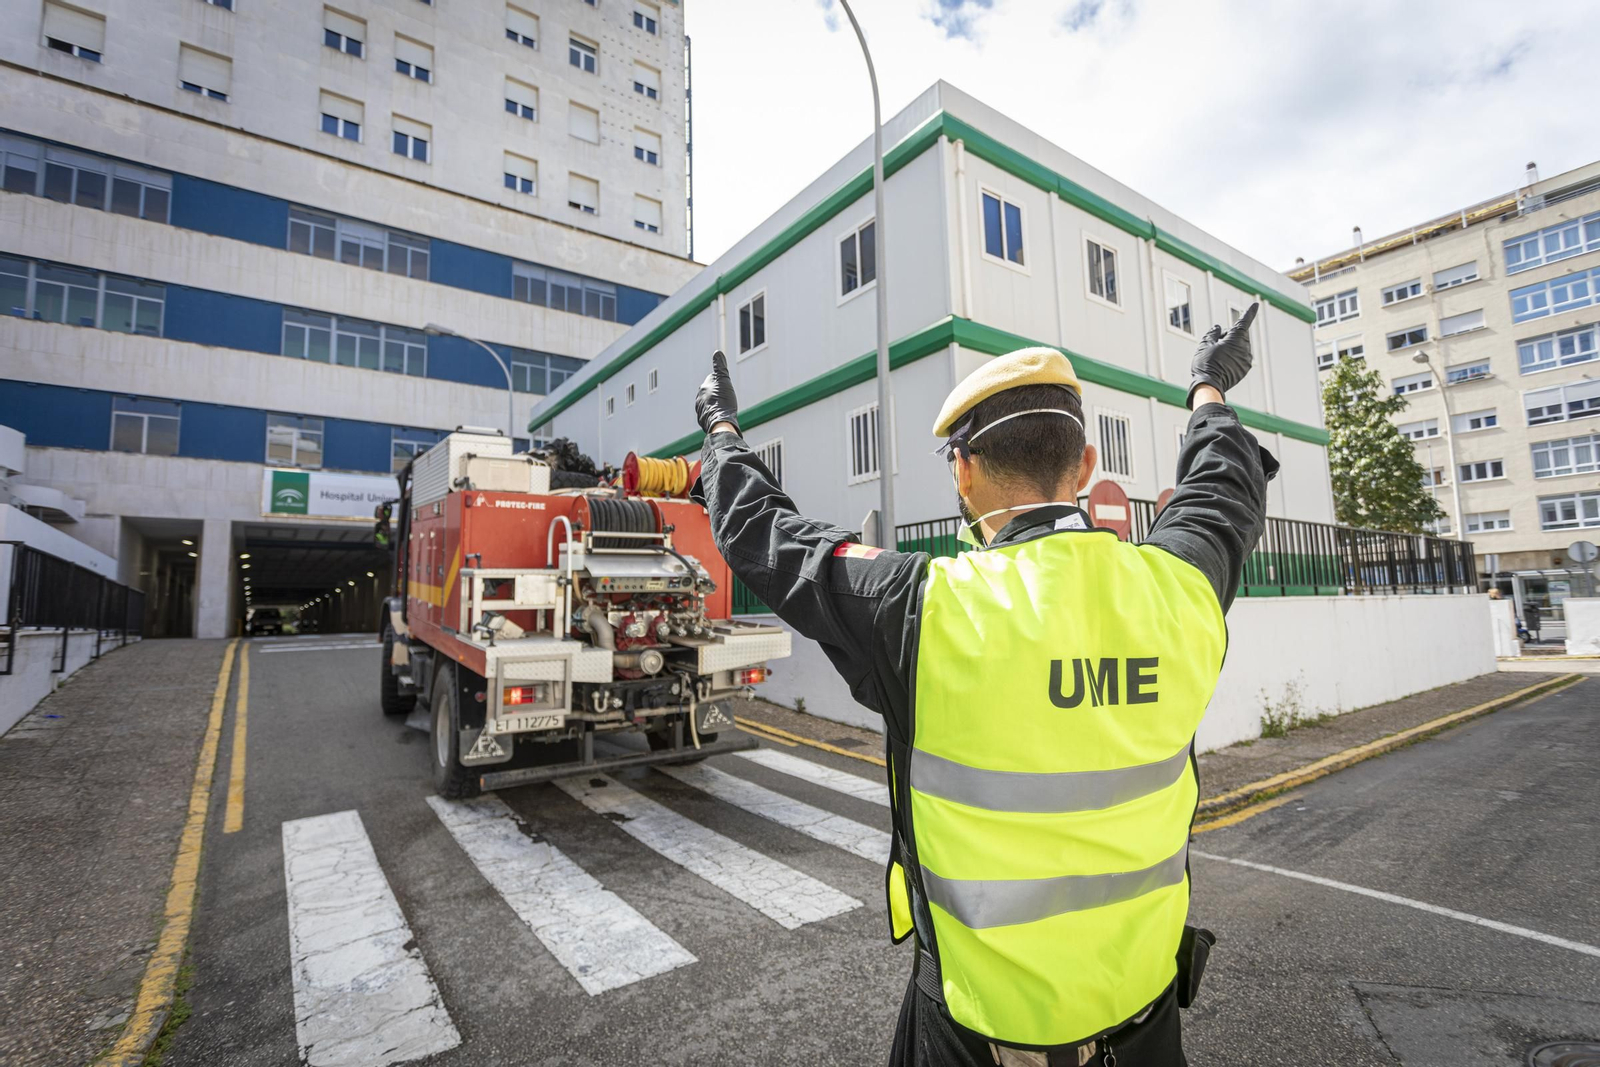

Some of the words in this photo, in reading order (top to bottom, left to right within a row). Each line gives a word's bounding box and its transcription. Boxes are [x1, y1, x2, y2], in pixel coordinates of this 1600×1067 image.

[320, 490, 364, 503] Hospital
[495, 500, 546, 510] PROTEC-FIRE
[1048, 656, 1159, 709] UME
[517, 715, 559, 730] 112775
